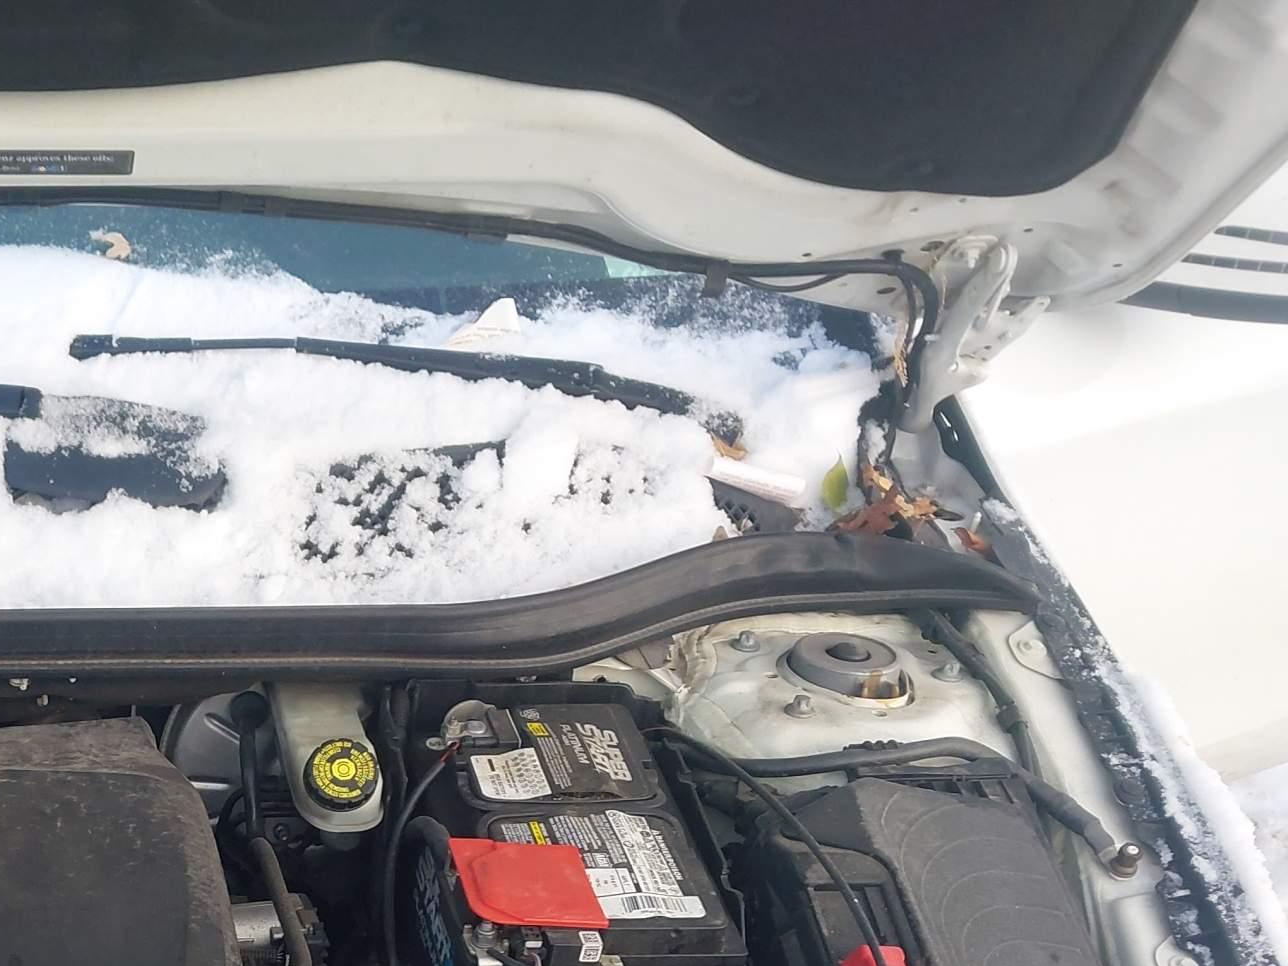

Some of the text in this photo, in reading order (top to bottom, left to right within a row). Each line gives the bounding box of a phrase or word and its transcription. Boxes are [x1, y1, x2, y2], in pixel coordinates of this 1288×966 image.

[15, 155, 61, 163] approves
[63, 153, 91, 162] these
[559, 724, 591, 765] PLATINUM
[574, 722, 614, 776] START
[600, 729, 633, 781] SUPER
